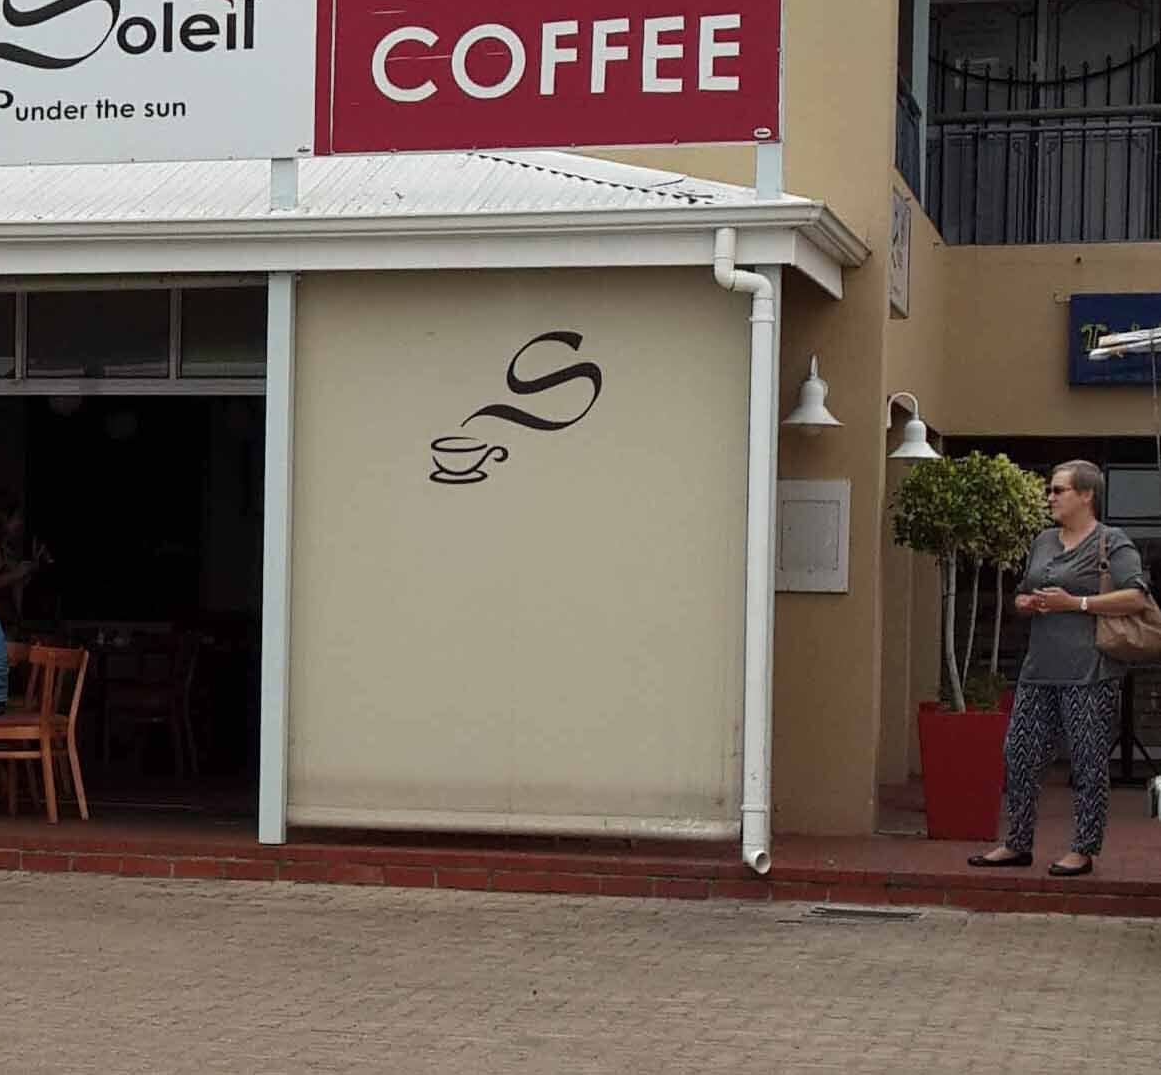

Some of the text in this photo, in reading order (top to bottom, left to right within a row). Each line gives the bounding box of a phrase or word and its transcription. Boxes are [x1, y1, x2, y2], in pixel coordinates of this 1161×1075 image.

[372, 13, 741, 103] COFFEE
[15, 100, 88, 122] under
[96, 98, 136, 119] the
[144, 101, 186, 118] sun
